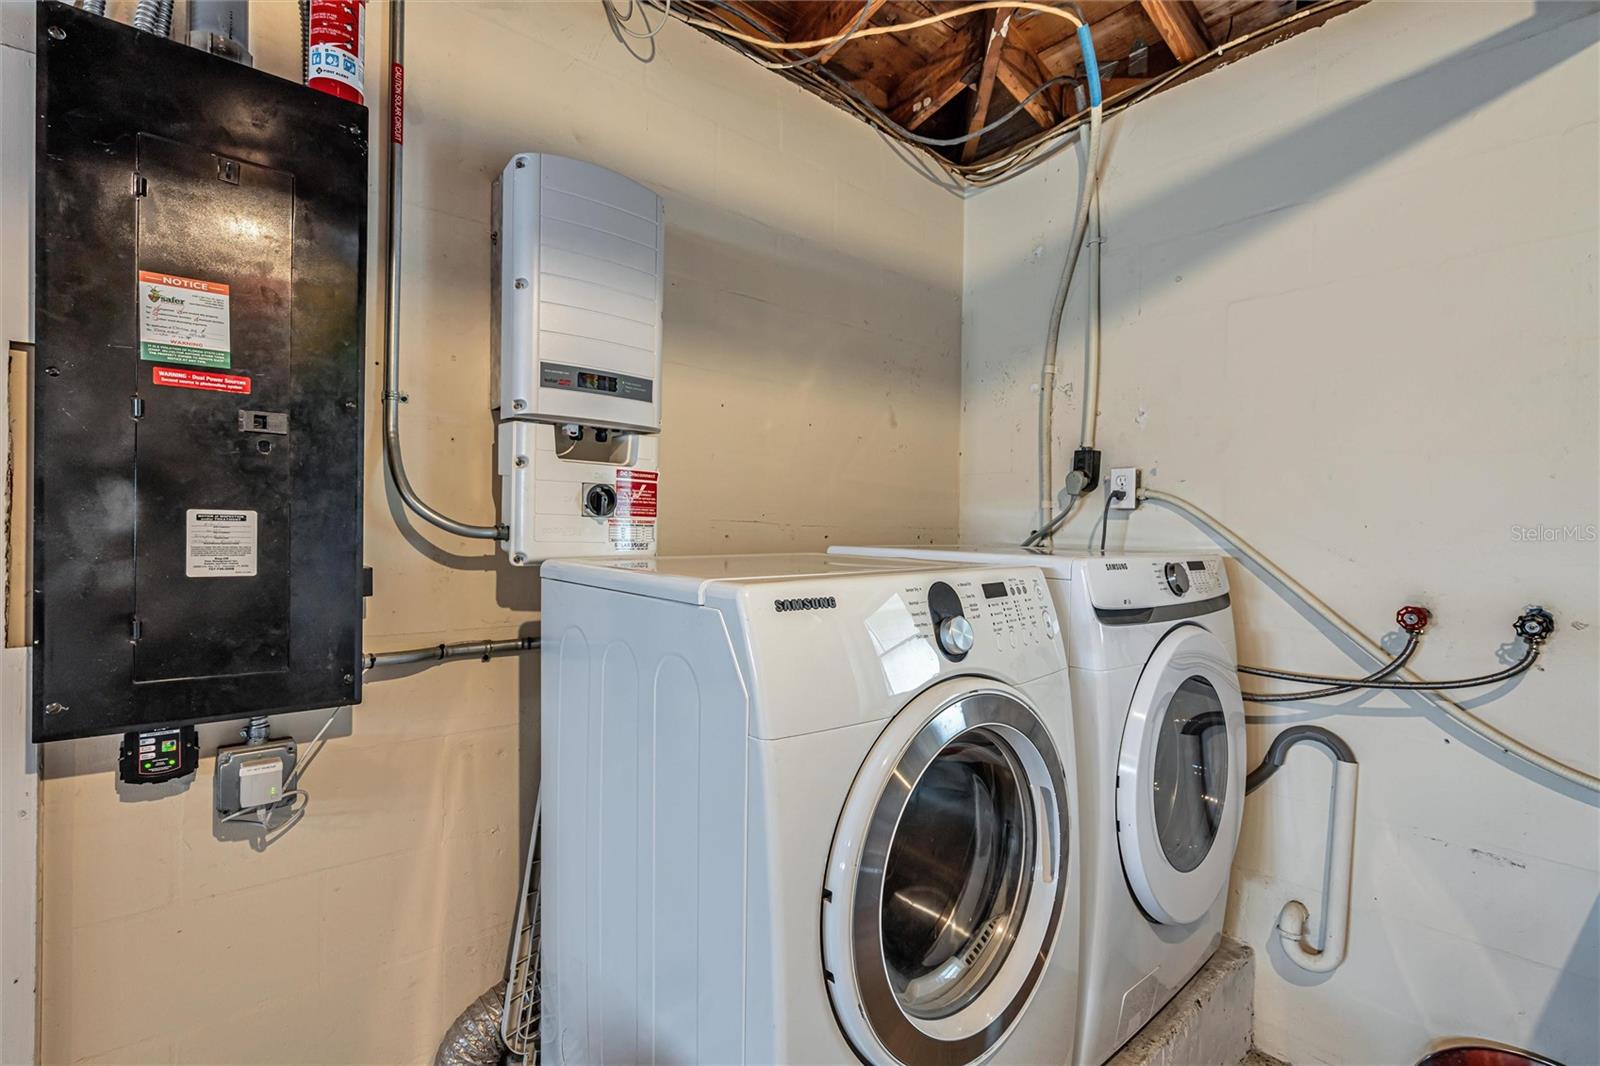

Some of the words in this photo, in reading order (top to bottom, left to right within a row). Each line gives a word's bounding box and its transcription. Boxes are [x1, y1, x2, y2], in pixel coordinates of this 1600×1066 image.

[394, 66, 403, 94] CAUTION
[394, 94, 403, 116] SOLAR
[394, 116, 403, 142] CIRCUIT
[162, 276, 209, 291] NOTICE
[160, 294, 185, 305] safer
[170, 339, 204, 348] WARNING
[158, 371, 187, 379] WARNING
[629, 471, 656, 479] Disconnect
[1105, 563, 1128, 571] SAMSUNG
[774, 596, 837, 612] SAMSUNG
